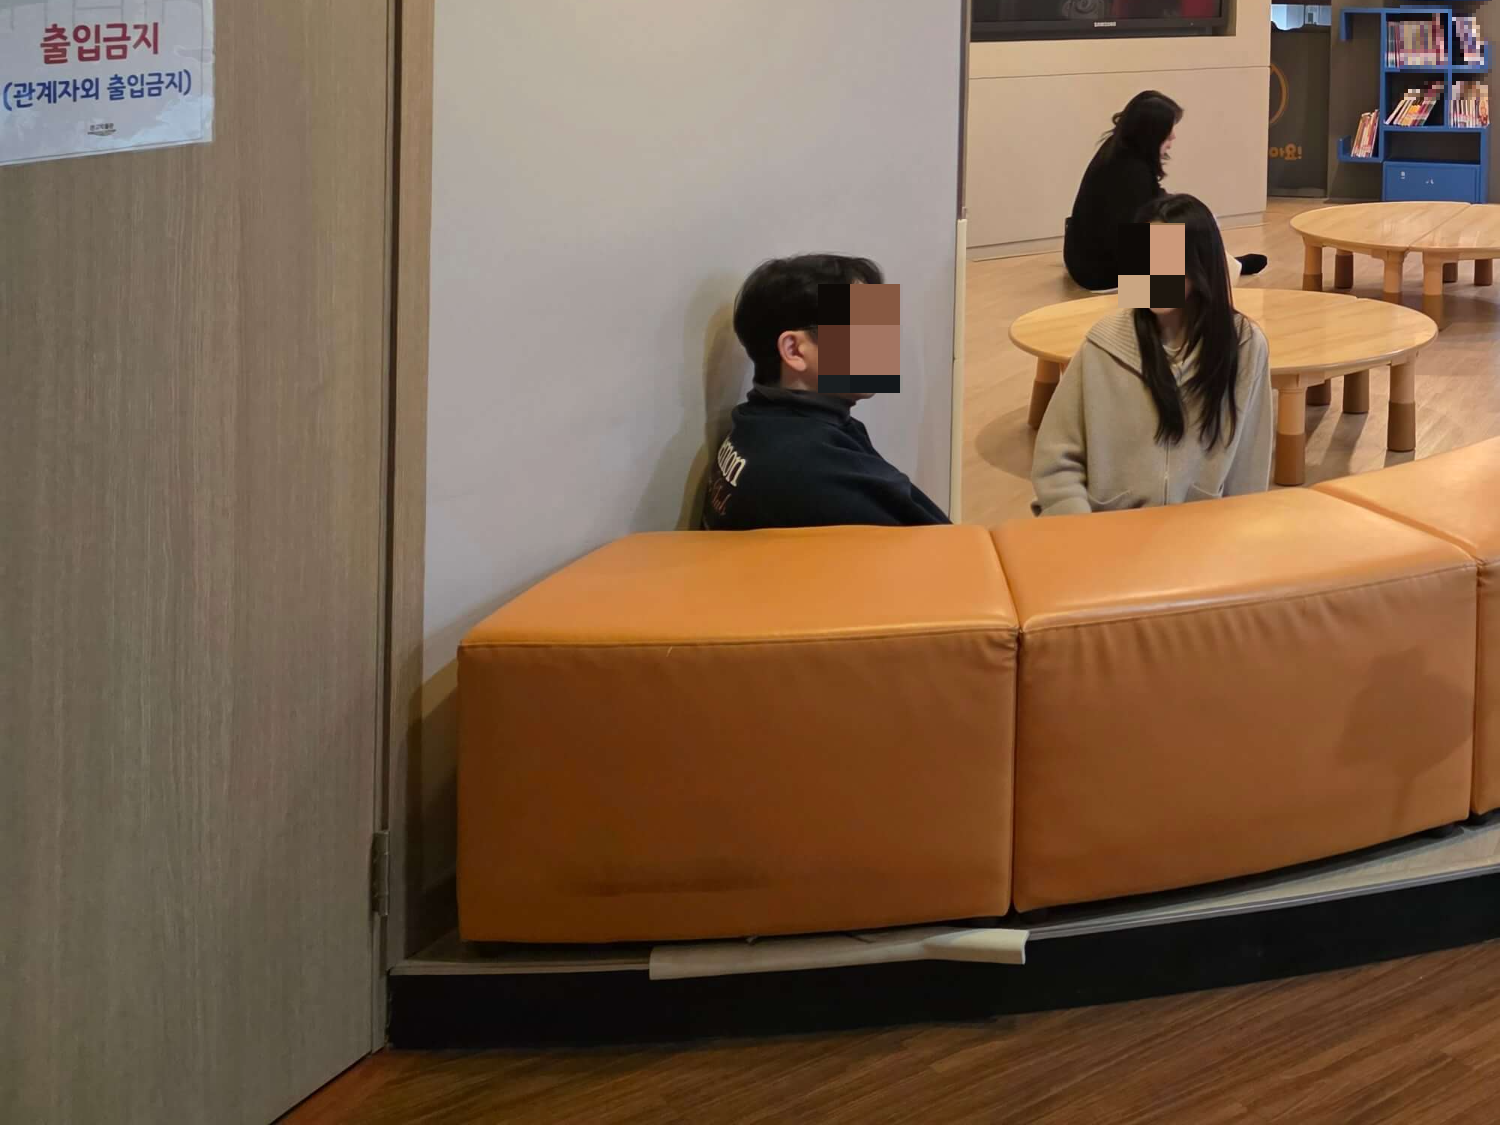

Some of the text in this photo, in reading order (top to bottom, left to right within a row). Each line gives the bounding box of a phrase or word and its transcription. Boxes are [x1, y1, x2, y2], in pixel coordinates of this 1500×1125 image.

[40, 22, 159, 65] 출입금지
[3, 69, 192, 111] (관계자외 출입금지)
